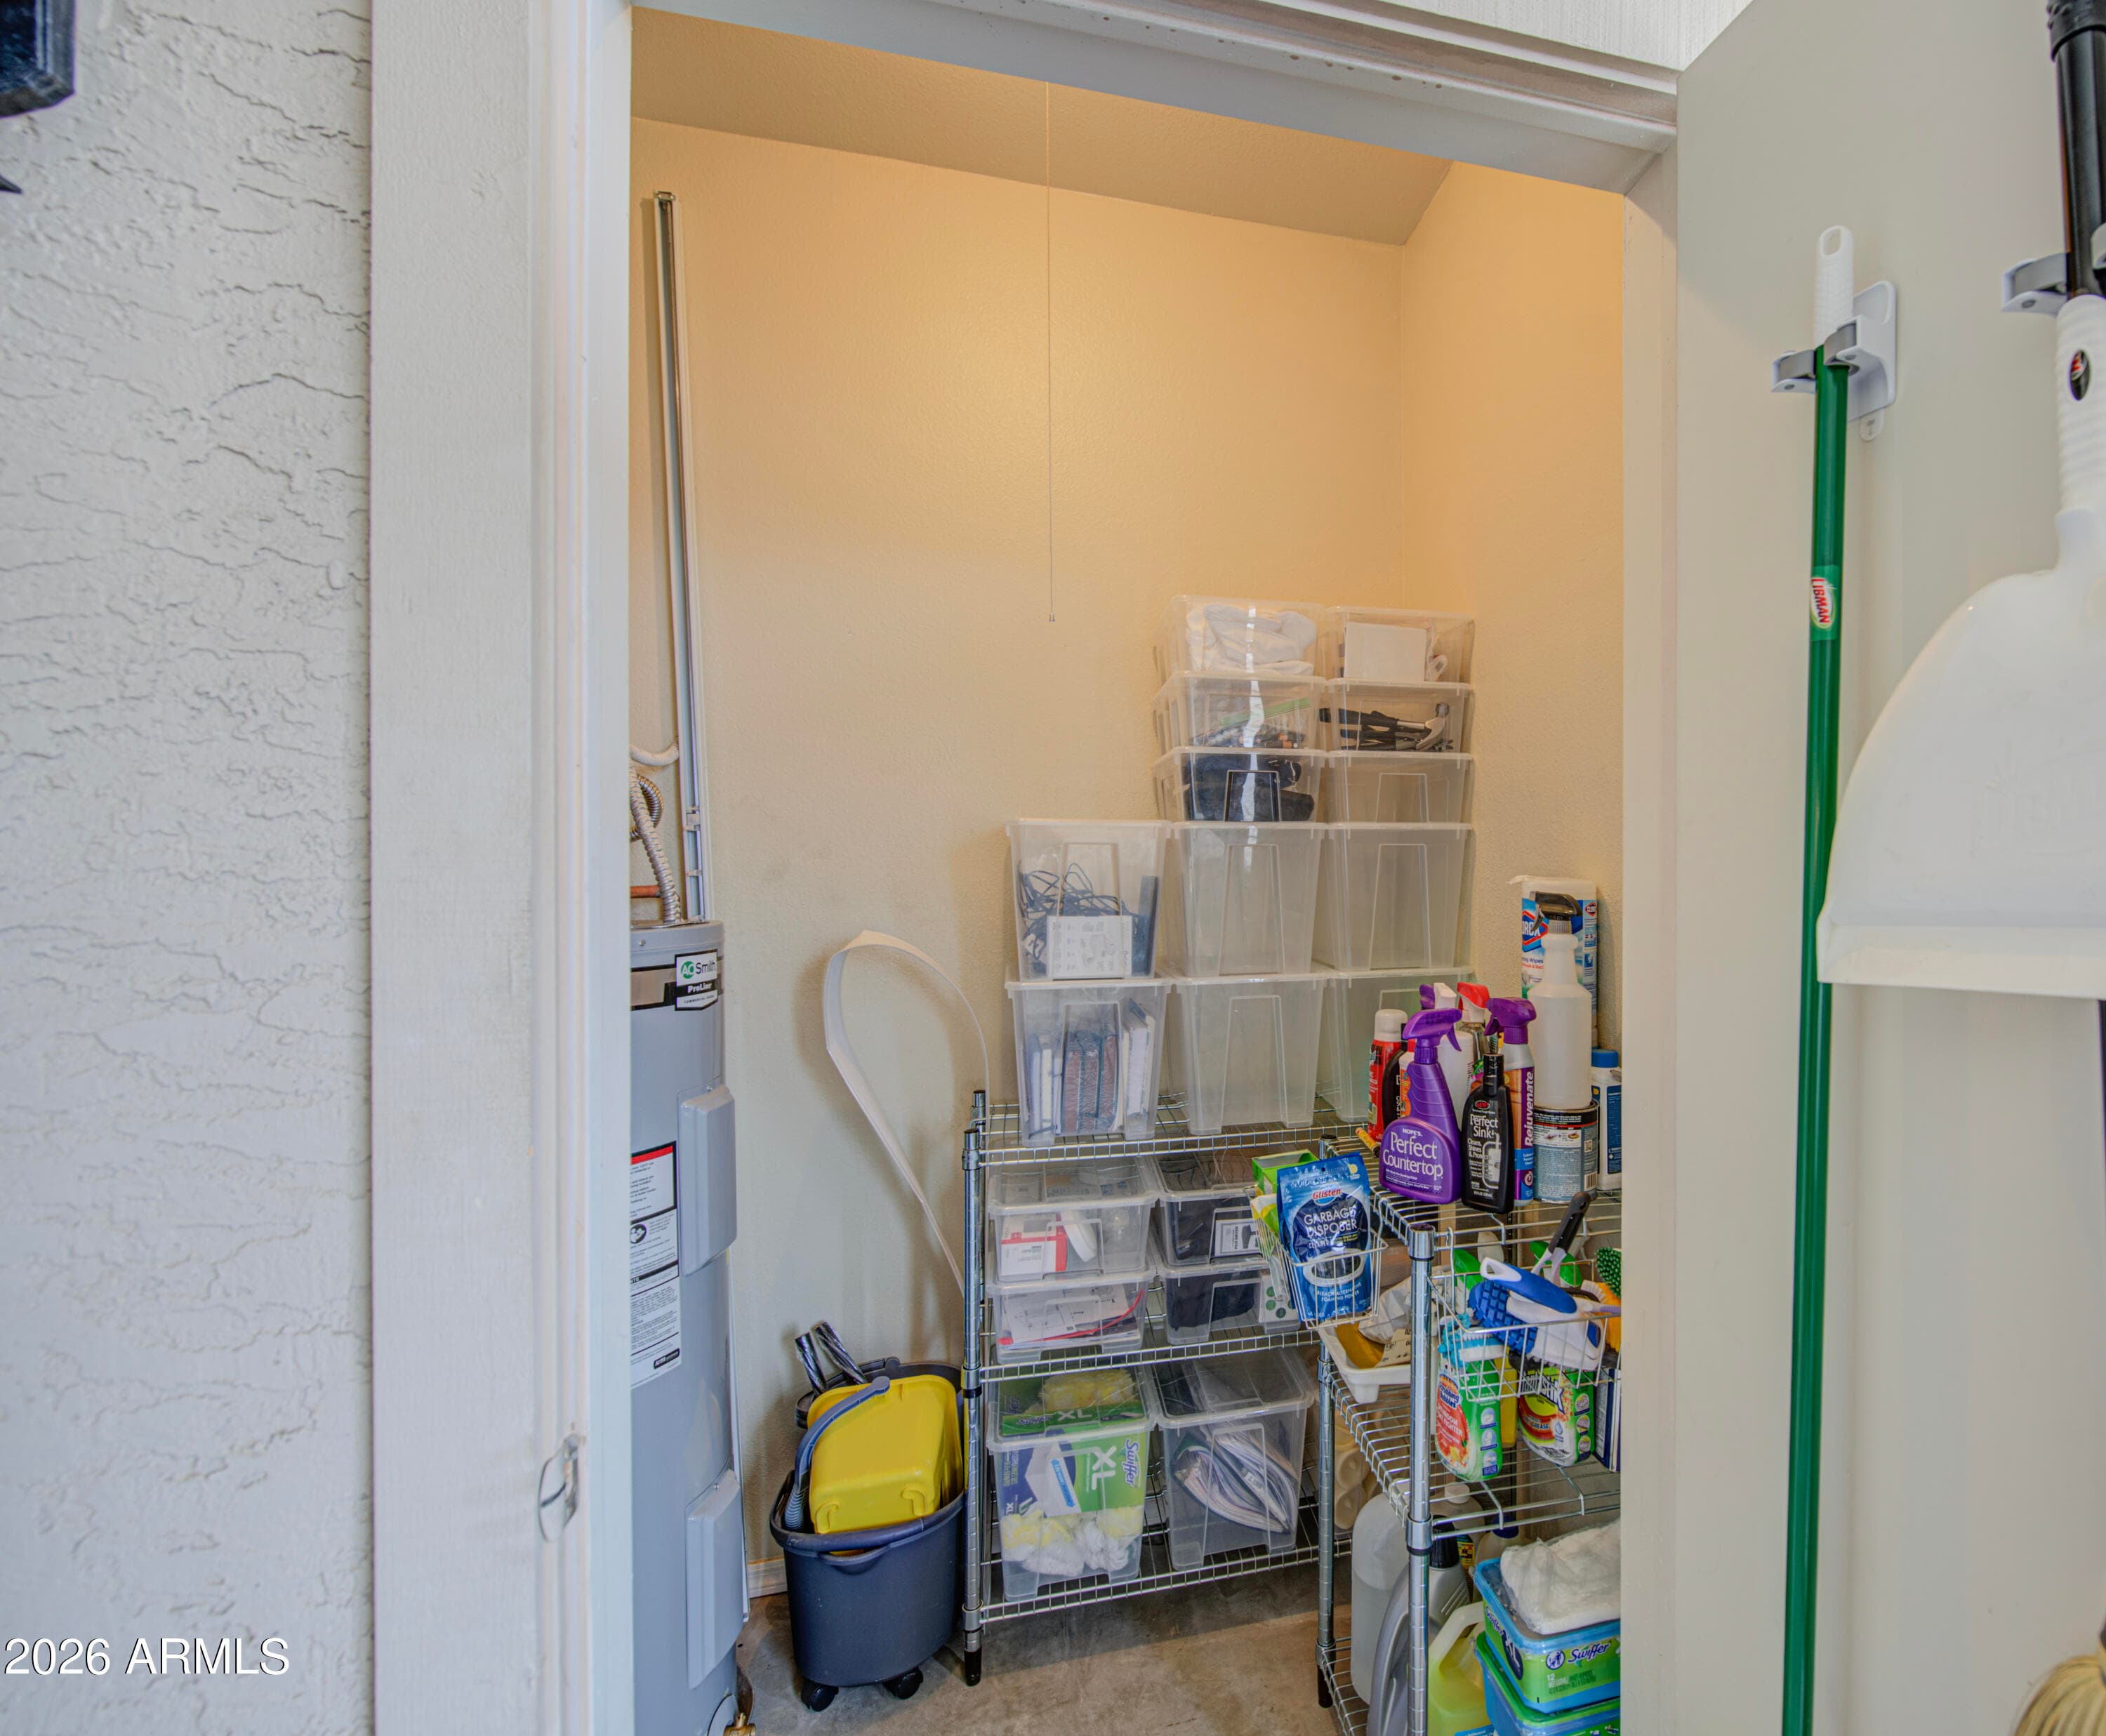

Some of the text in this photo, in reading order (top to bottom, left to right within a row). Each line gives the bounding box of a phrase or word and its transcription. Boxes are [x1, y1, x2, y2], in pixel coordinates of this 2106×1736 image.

[1810, 578, 1831, 624] LIBMAN
[696, 960, 716, 974] Smith
[1524, 1071, 1535, 1146] Rejuvenate
[1470, 1113, 1499, 1129] Perfect
[1390, 1132, 1438, 1160] Perfect
[1312, 1188, 1342, 1200] Glisten
[1304, 1207, 1356, 1225] GARBAGE
[1307, 1219, 1358, 1238] DISPOSER
[1057, 1409, 1092, 1422] XL
[1092, 1445, 1118, 1490] XL
[1122, 1438, 1139, 1488] Swiffer
[1567, 1643, 1610, 1662] Swiffer
